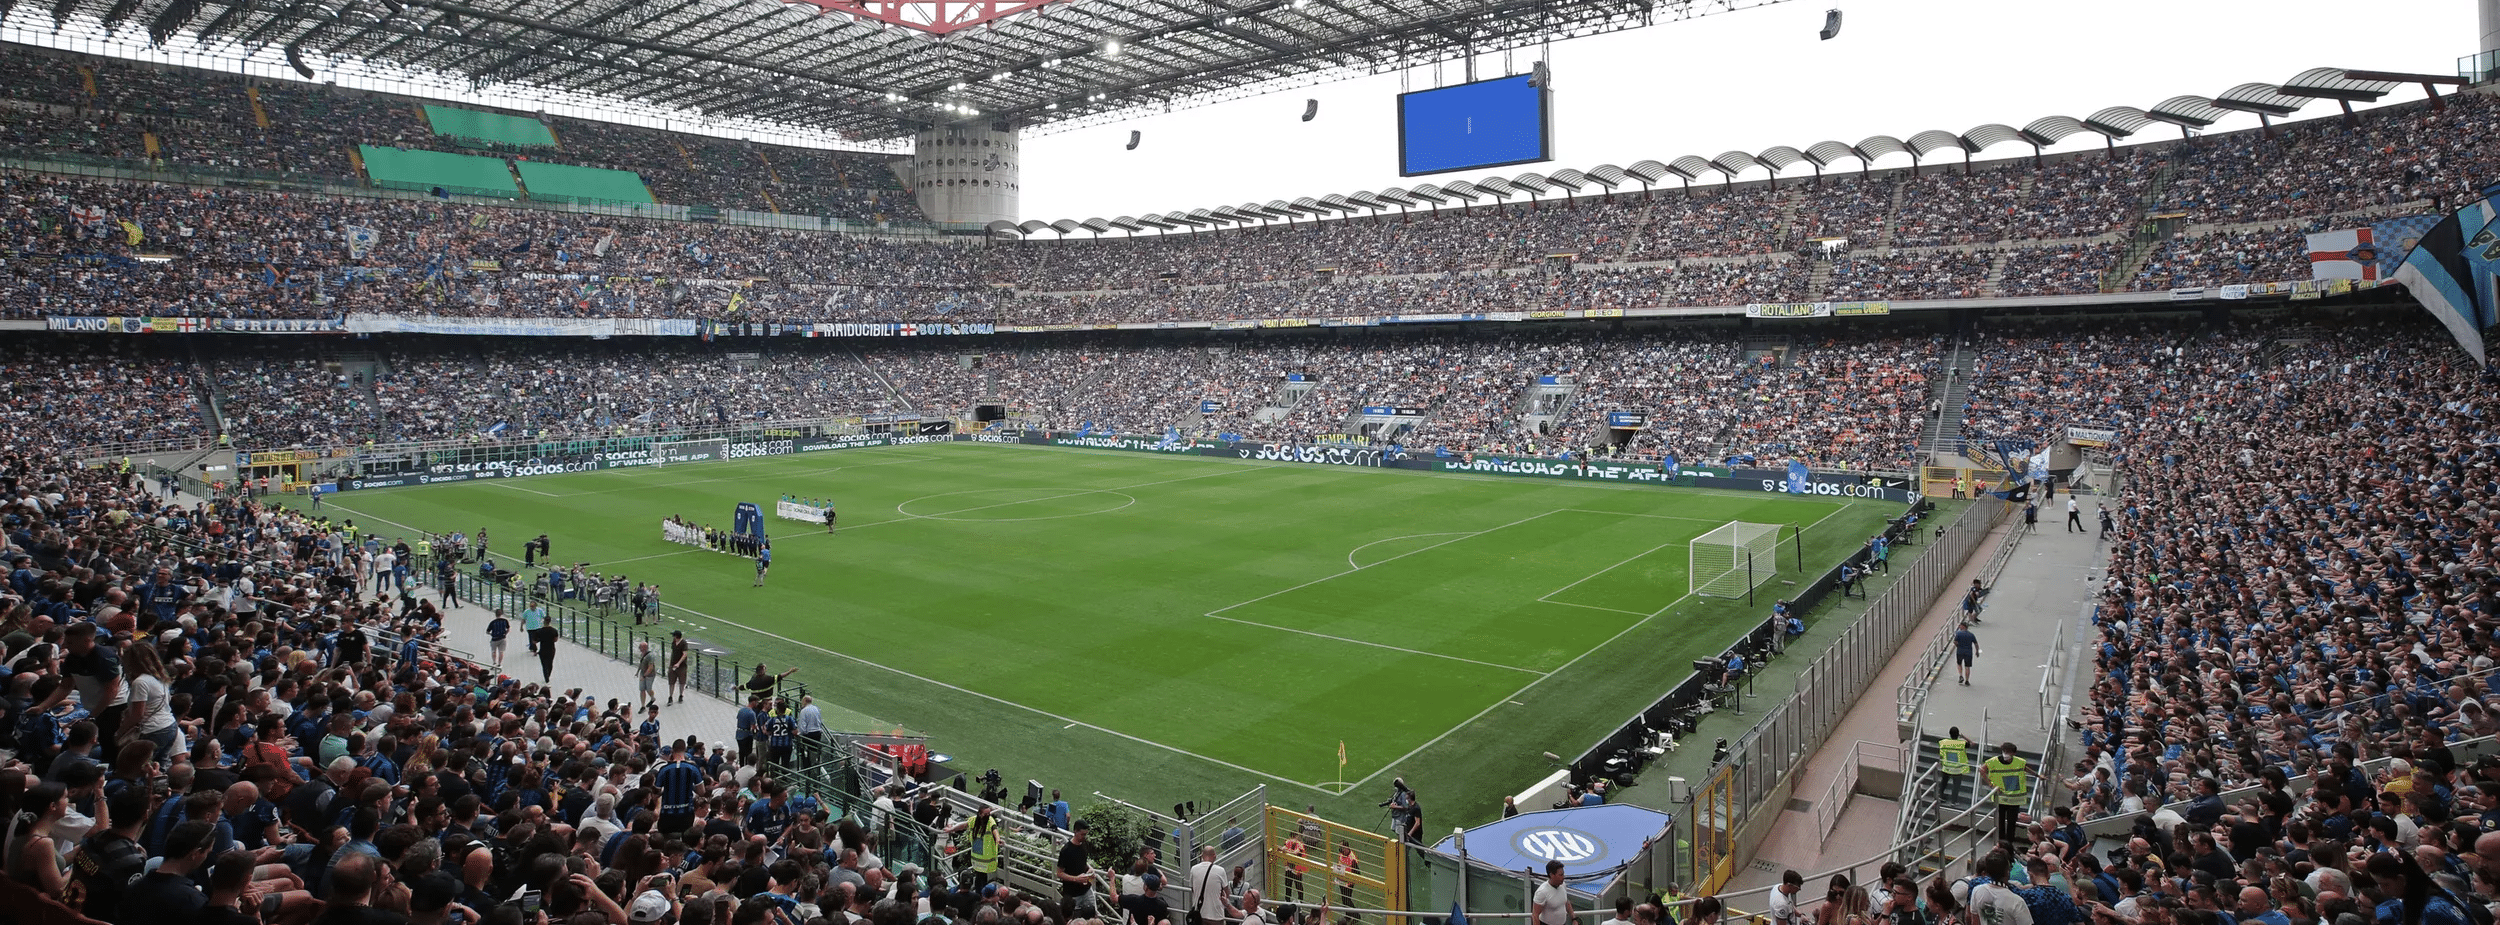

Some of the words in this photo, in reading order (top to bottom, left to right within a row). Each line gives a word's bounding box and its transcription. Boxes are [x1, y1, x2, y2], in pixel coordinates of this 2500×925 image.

[1761, 304, 1815, 316] ROTALIANO
[48, 317, 108, 331] MILANO
[234, 320, 331, 331] BRIANZA
[919, 323, 951, 336] BOYS
[960, 323, 995, 335] ROMA
[1013, 325, 1044, 333] TORRITA
[802, 442, 847, 452] DOWNLOAD
[849, 440, 865, 448] THE
[1316, 433, 1370, 447] TEMPLARI
[609, 456, 666, 468] DOWNLOAD
[668, 454, 688, 464] THE
[690, 453, 710, 462] APP
[772, 723, 789, 737] 22
